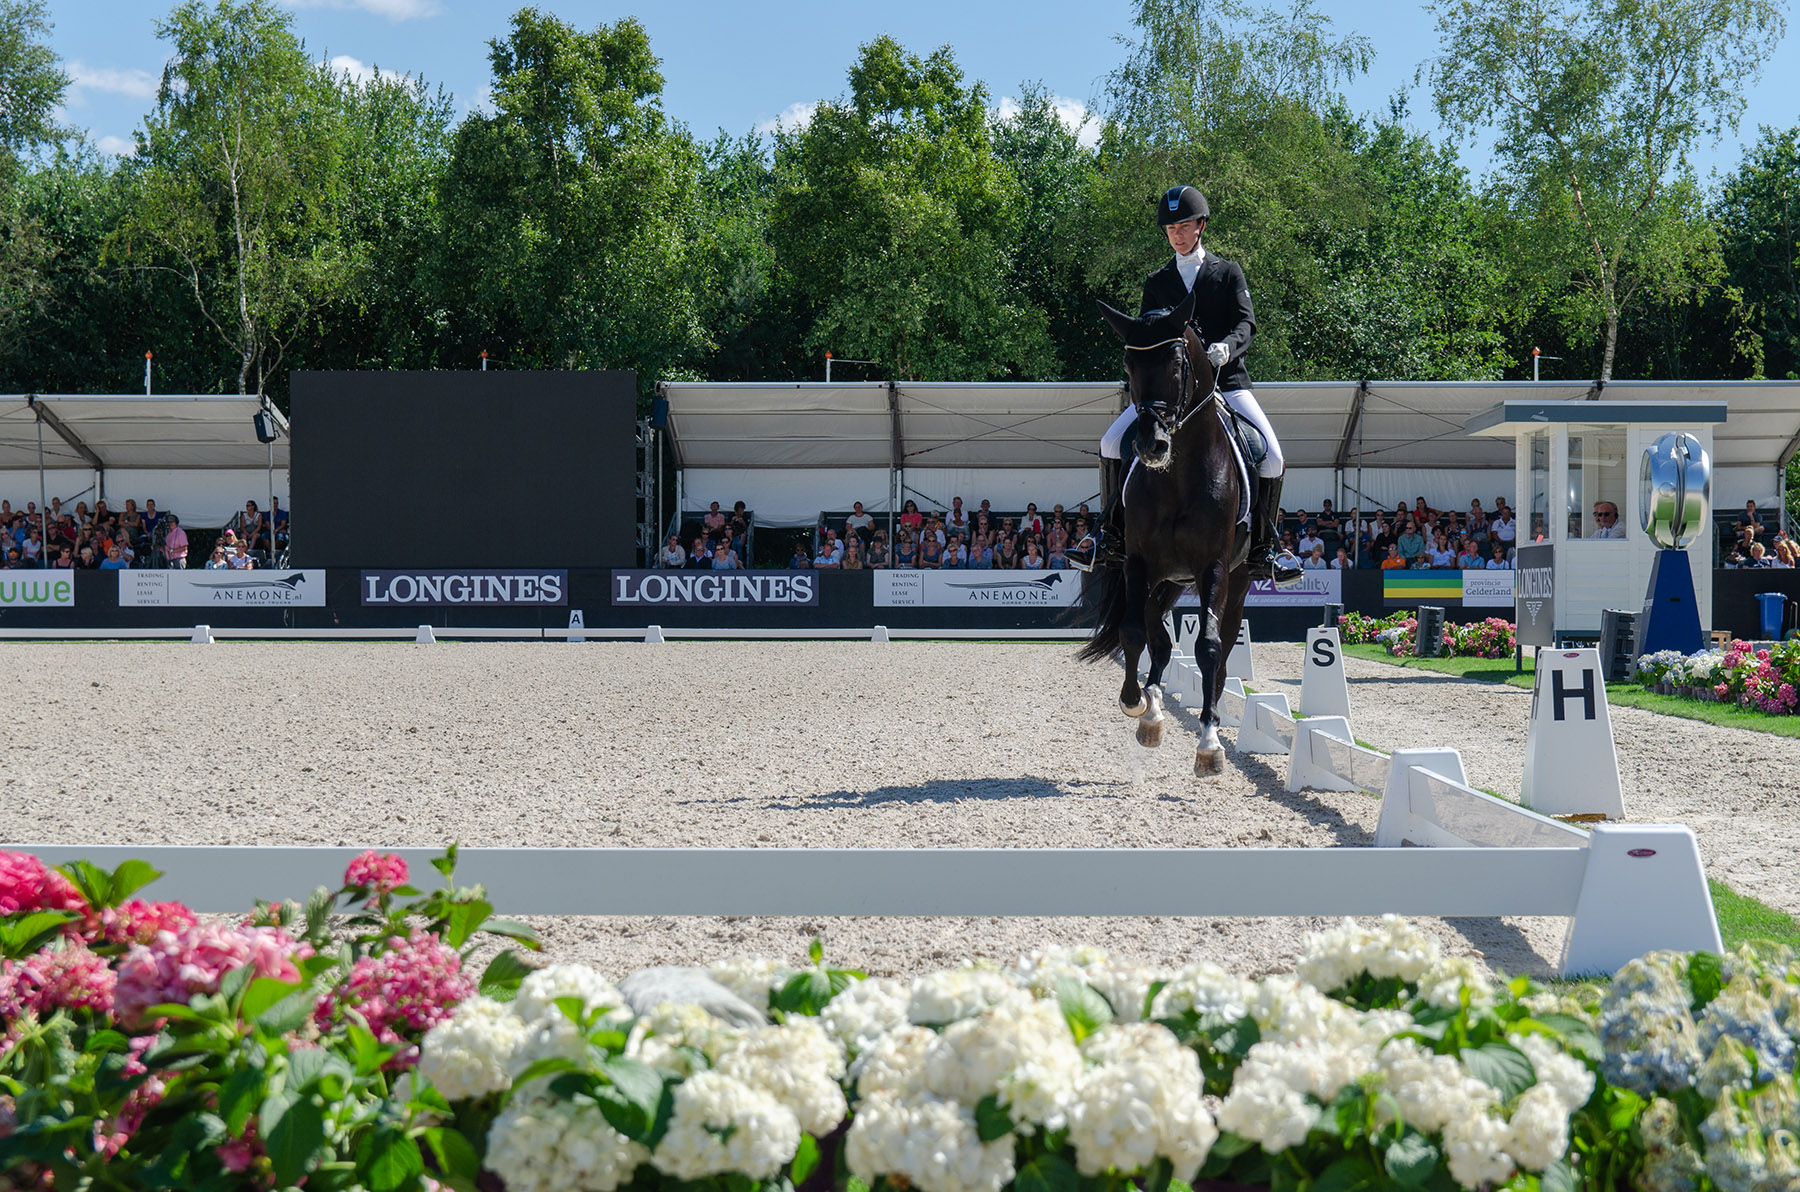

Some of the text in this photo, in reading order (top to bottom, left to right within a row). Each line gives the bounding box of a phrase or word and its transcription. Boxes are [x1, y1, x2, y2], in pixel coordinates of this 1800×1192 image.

[365, 575, 562, 603] LONGINES
[616, 575, 814, 603] LONGINES
[1470, 579, 1501, 588] provincie
[1518, 567, 1553, 599] LONGINES
[213, 590, 302, 601] ANEMONE.nl
[969, 590, 1059, 601] ANEMONE.nl
[1465, 587, 1512, 596] Gelderland
[571, 613, 581, 625] A
[1184, 620, 1197, 635] V
[1312, 638, 1336, 667] S
[1552, 668, 1596, 721] H
